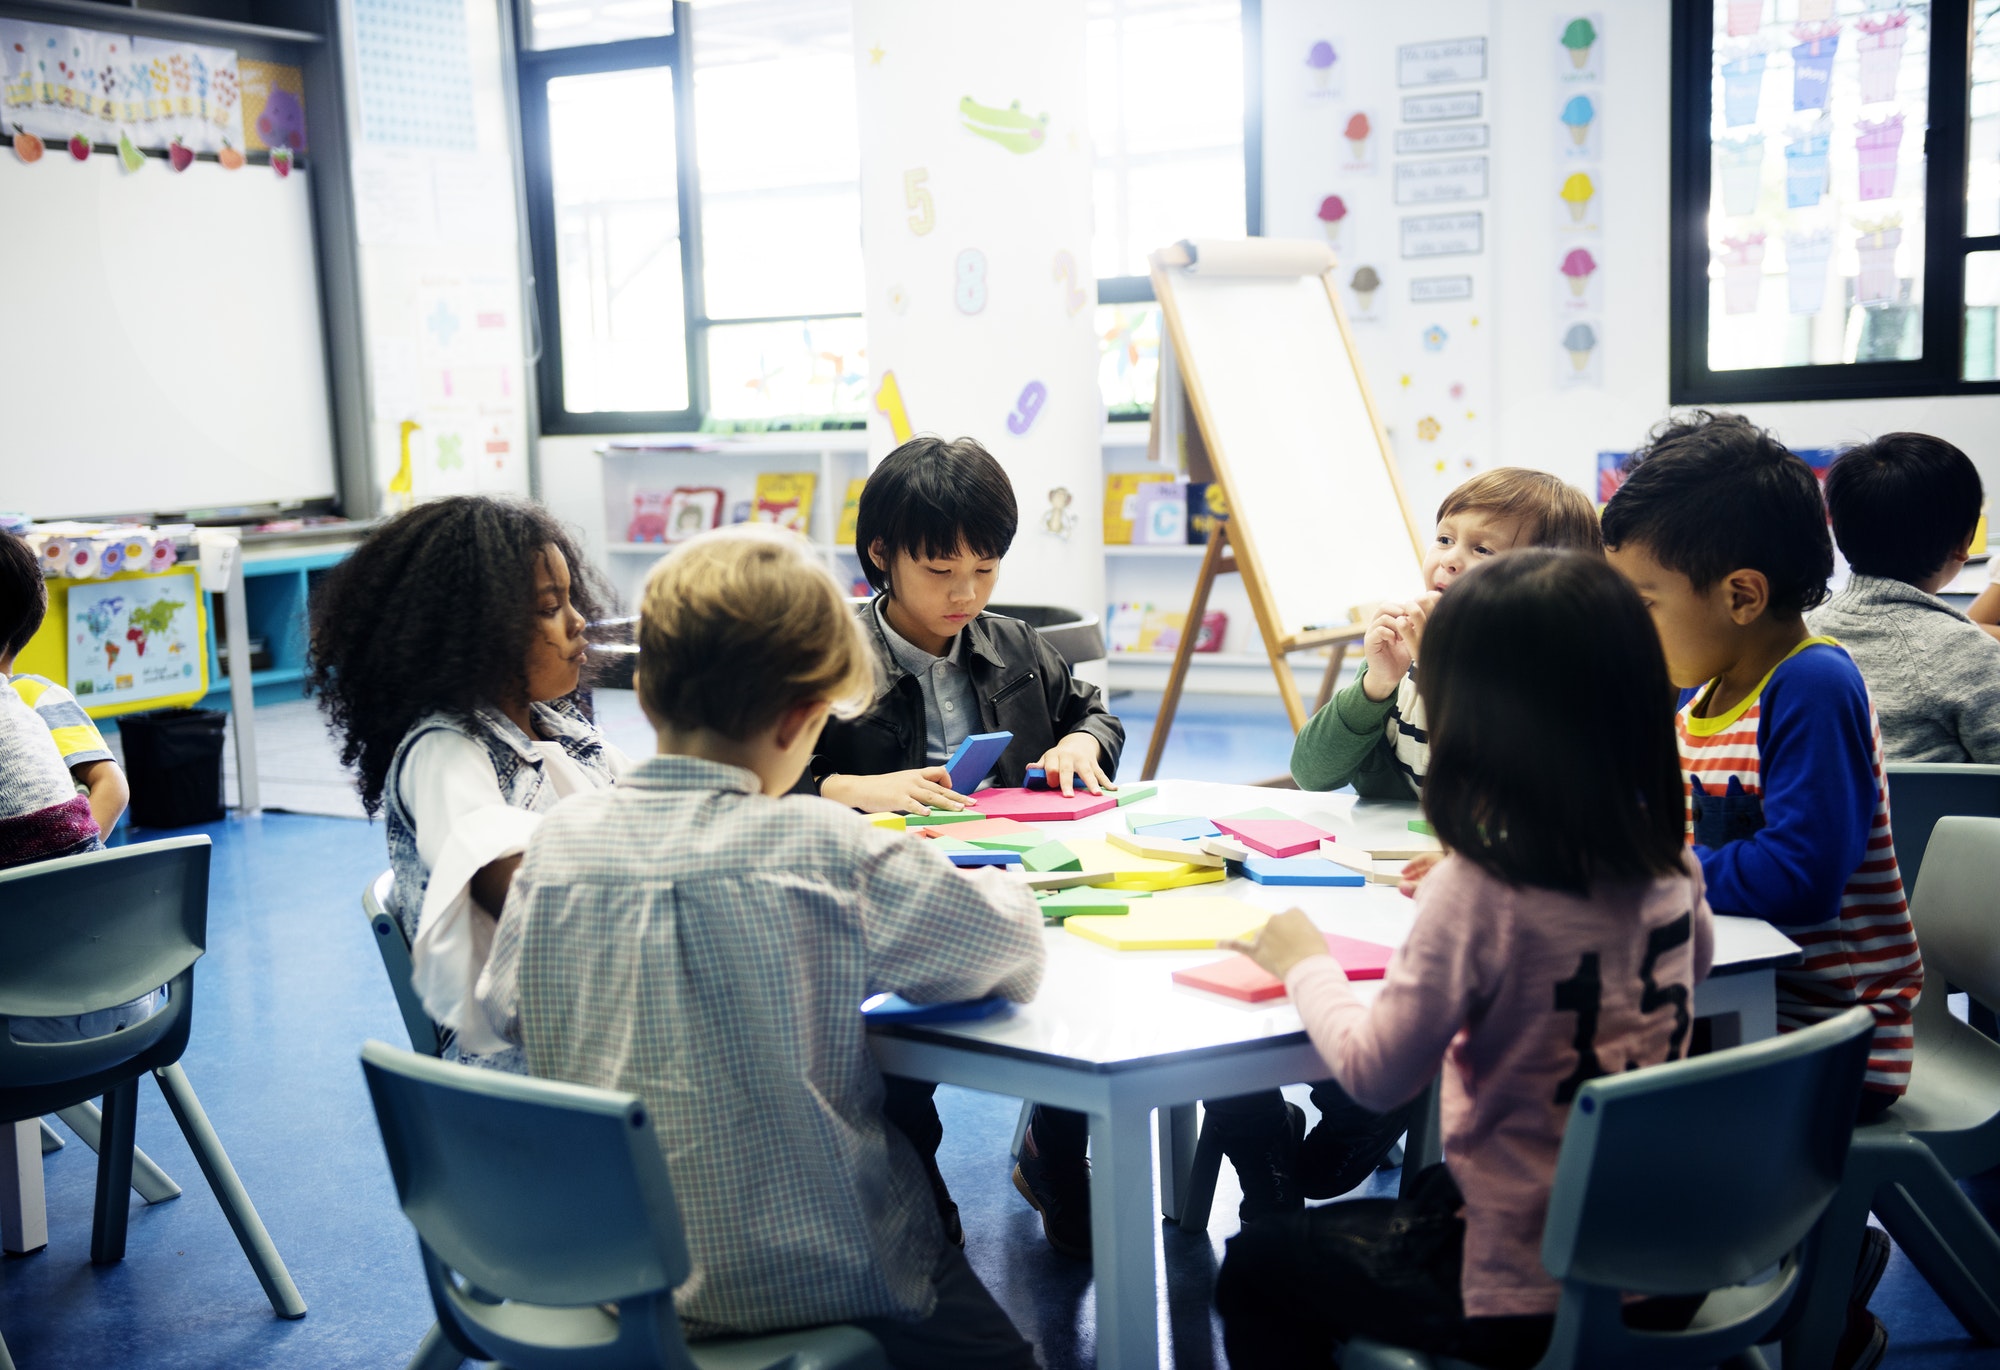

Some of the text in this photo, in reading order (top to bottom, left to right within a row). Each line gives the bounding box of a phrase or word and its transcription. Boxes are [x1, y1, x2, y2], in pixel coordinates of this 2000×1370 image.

[903, 166, 936, 237] 5
[955, 247, 989, 316] 8
[1052, 248, 1087, 318] 2
[875, 369, 914, 447] 1
[1006, 379, 1048, 437] 9
[1153, 502, 1179, 537] C
